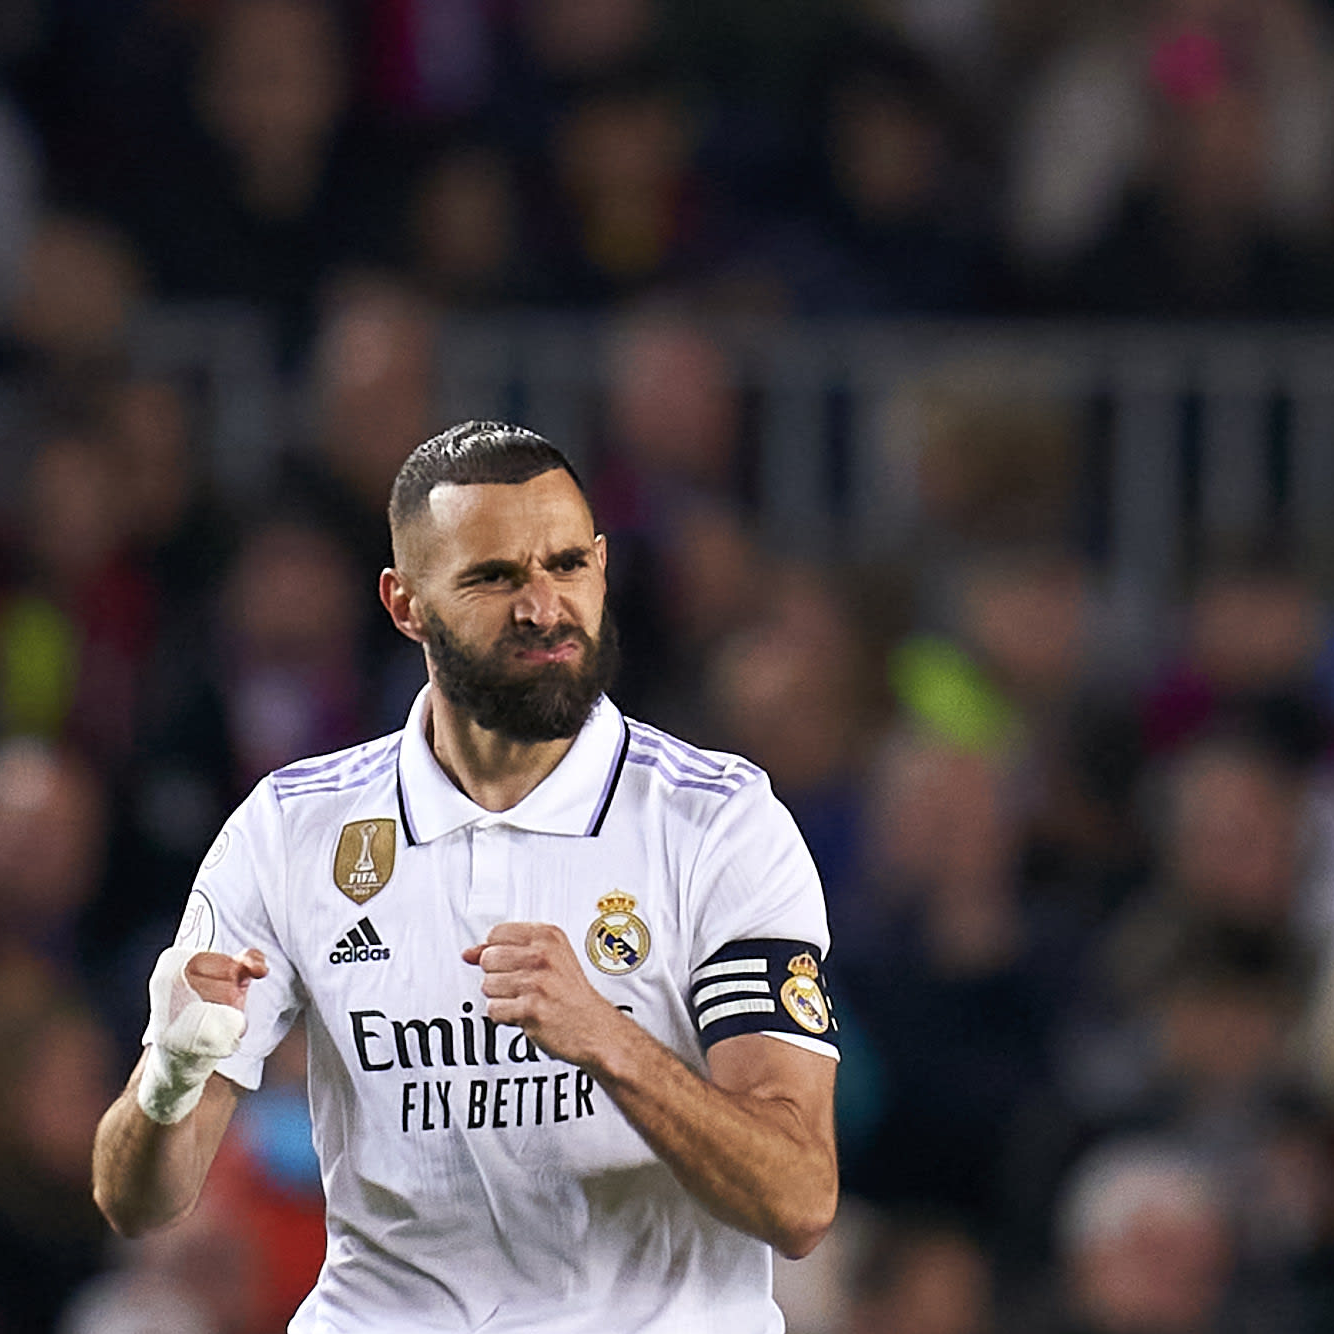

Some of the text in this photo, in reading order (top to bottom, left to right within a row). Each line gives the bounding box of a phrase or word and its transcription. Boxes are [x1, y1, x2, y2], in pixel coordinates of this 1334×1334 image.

[348, 871, 378, 884] FIFA
[329, 945, 391, 965] adidas
[402, 1068, 595, 1132] FLY BETTER
